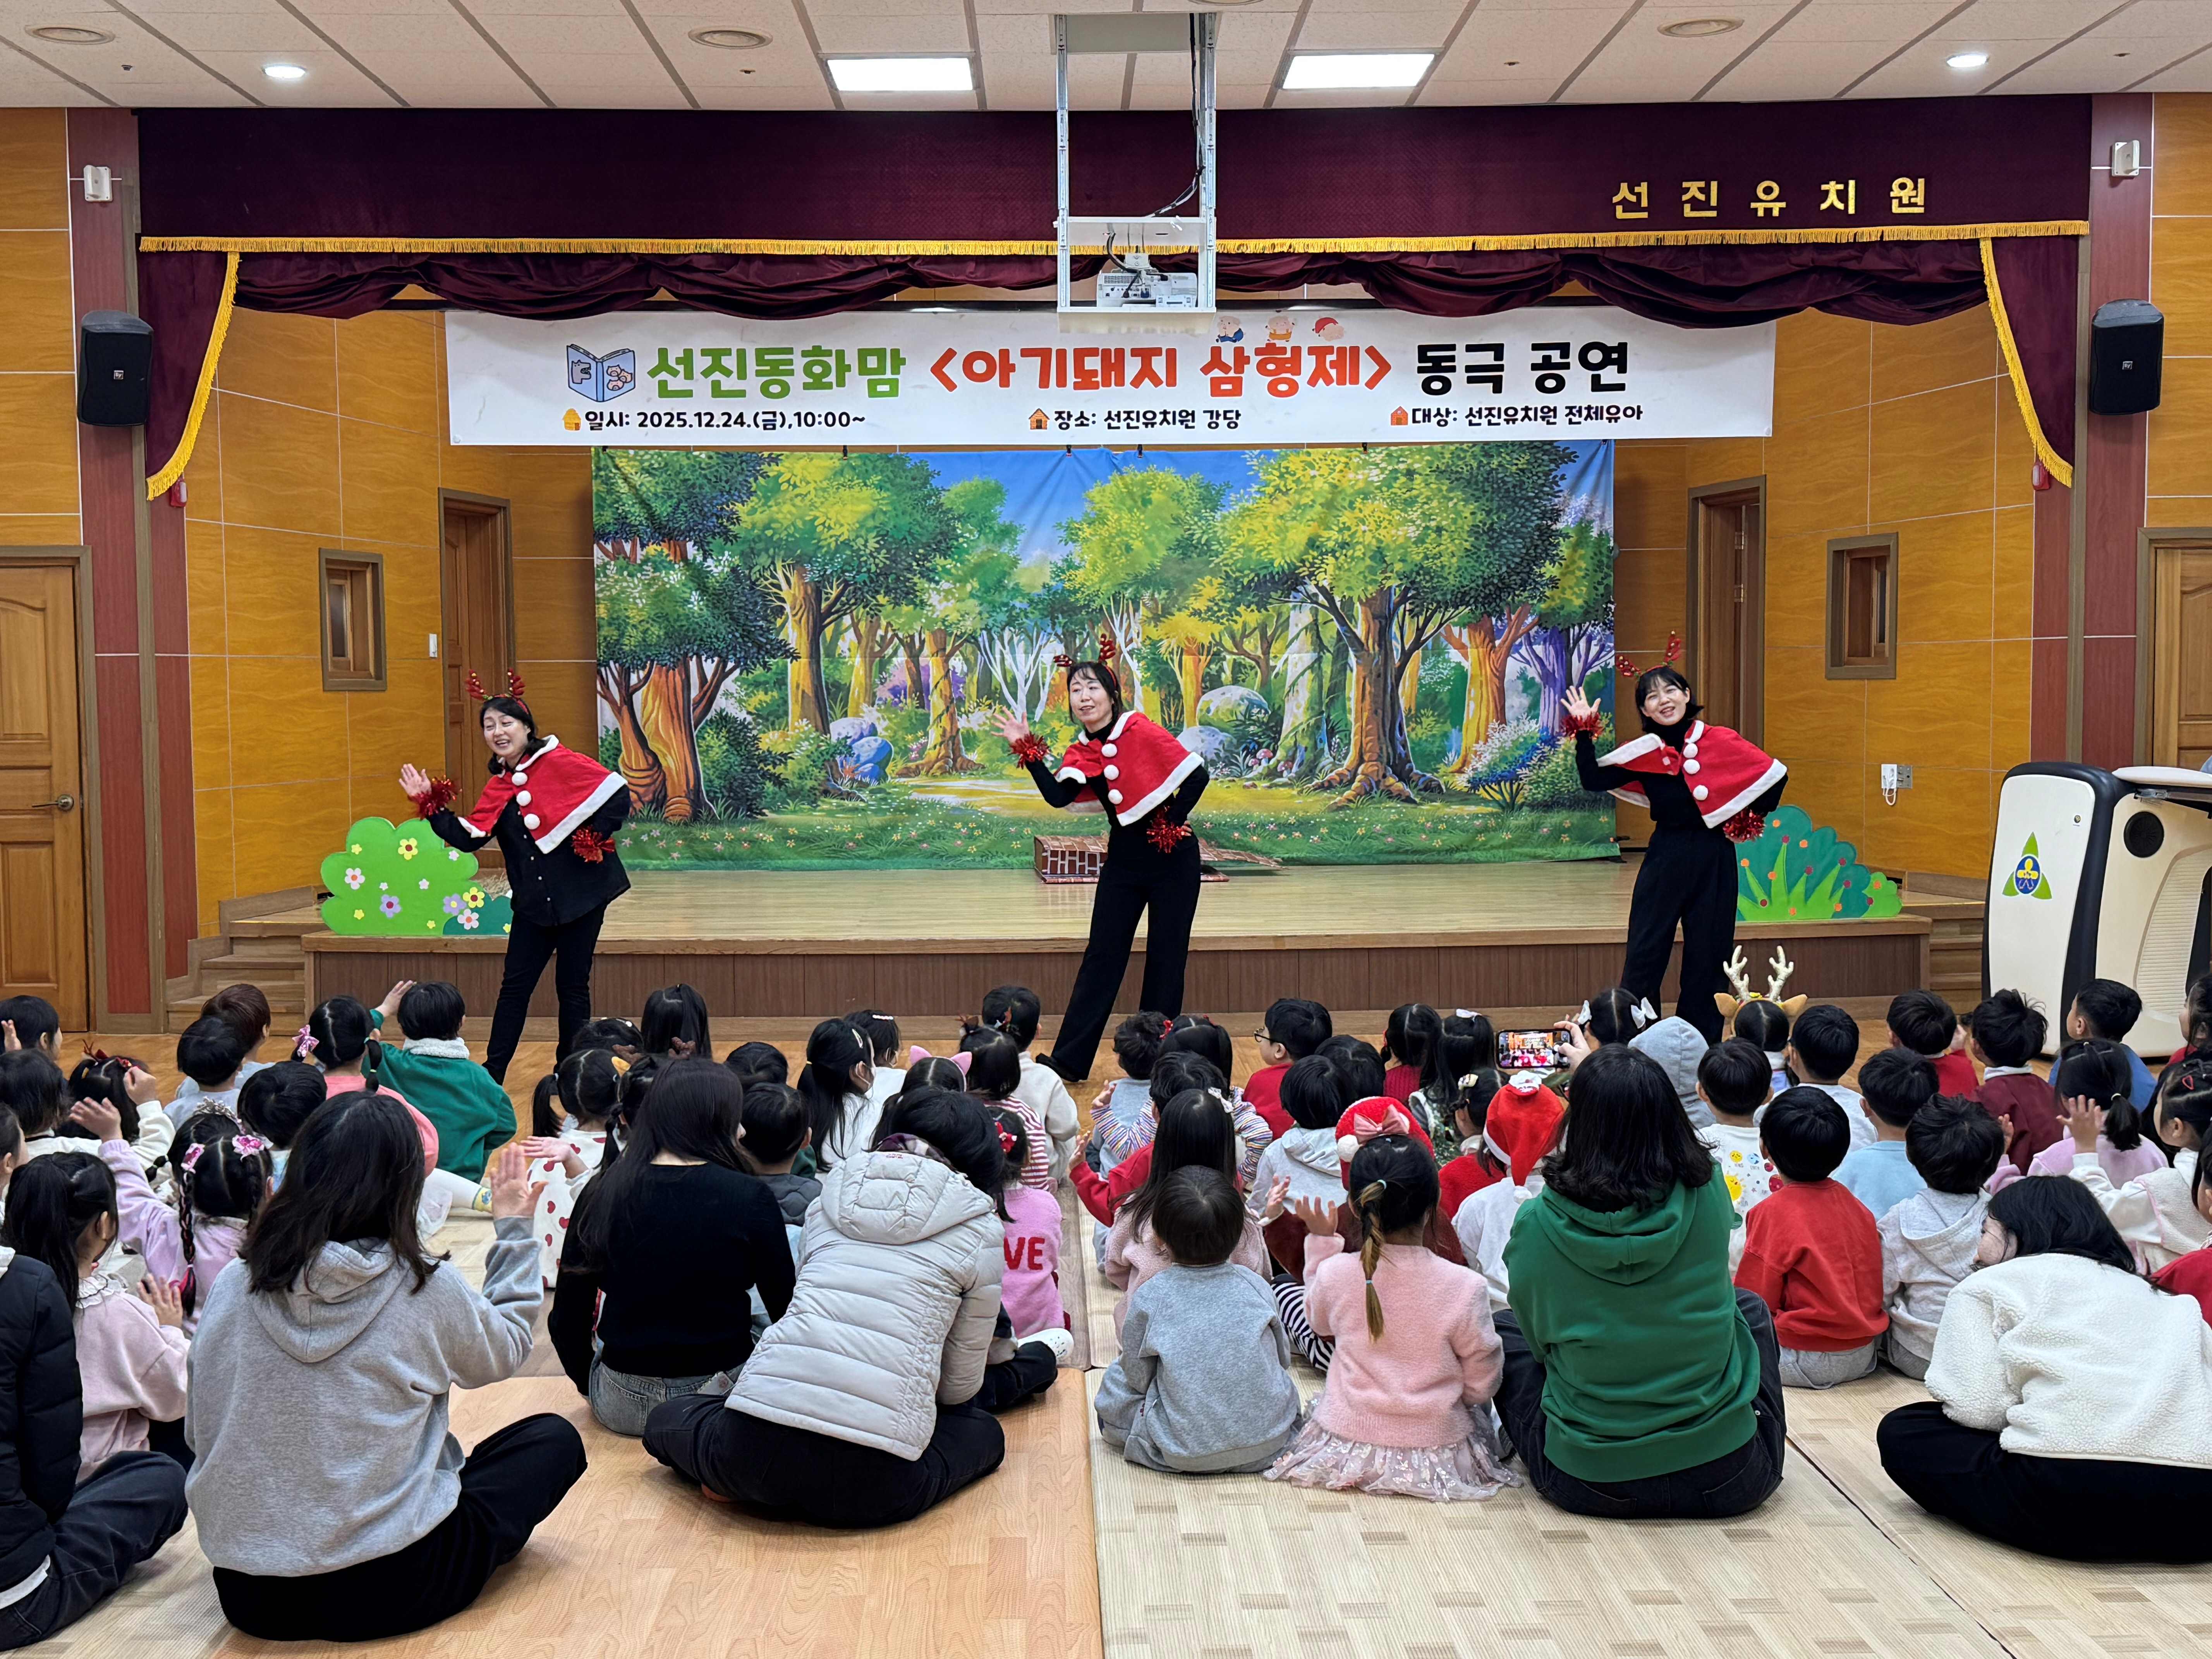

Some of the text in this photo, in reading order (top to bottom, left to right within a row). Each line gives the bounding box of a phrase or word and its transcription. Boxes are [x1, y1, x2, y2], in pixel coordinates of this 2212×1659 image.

[647, 341, 1628, 399] 선진동화맘 <아기돼지 삼형제> 동극 공연
[585, 411, 865, 431] 일시: 2025.12.24.(금),10:00~
[1054, 409, 1241, 430] 장소: 선진유치원 강당
[1412, 405, 1643, 427] 대상: 선진유치원 전체유아
